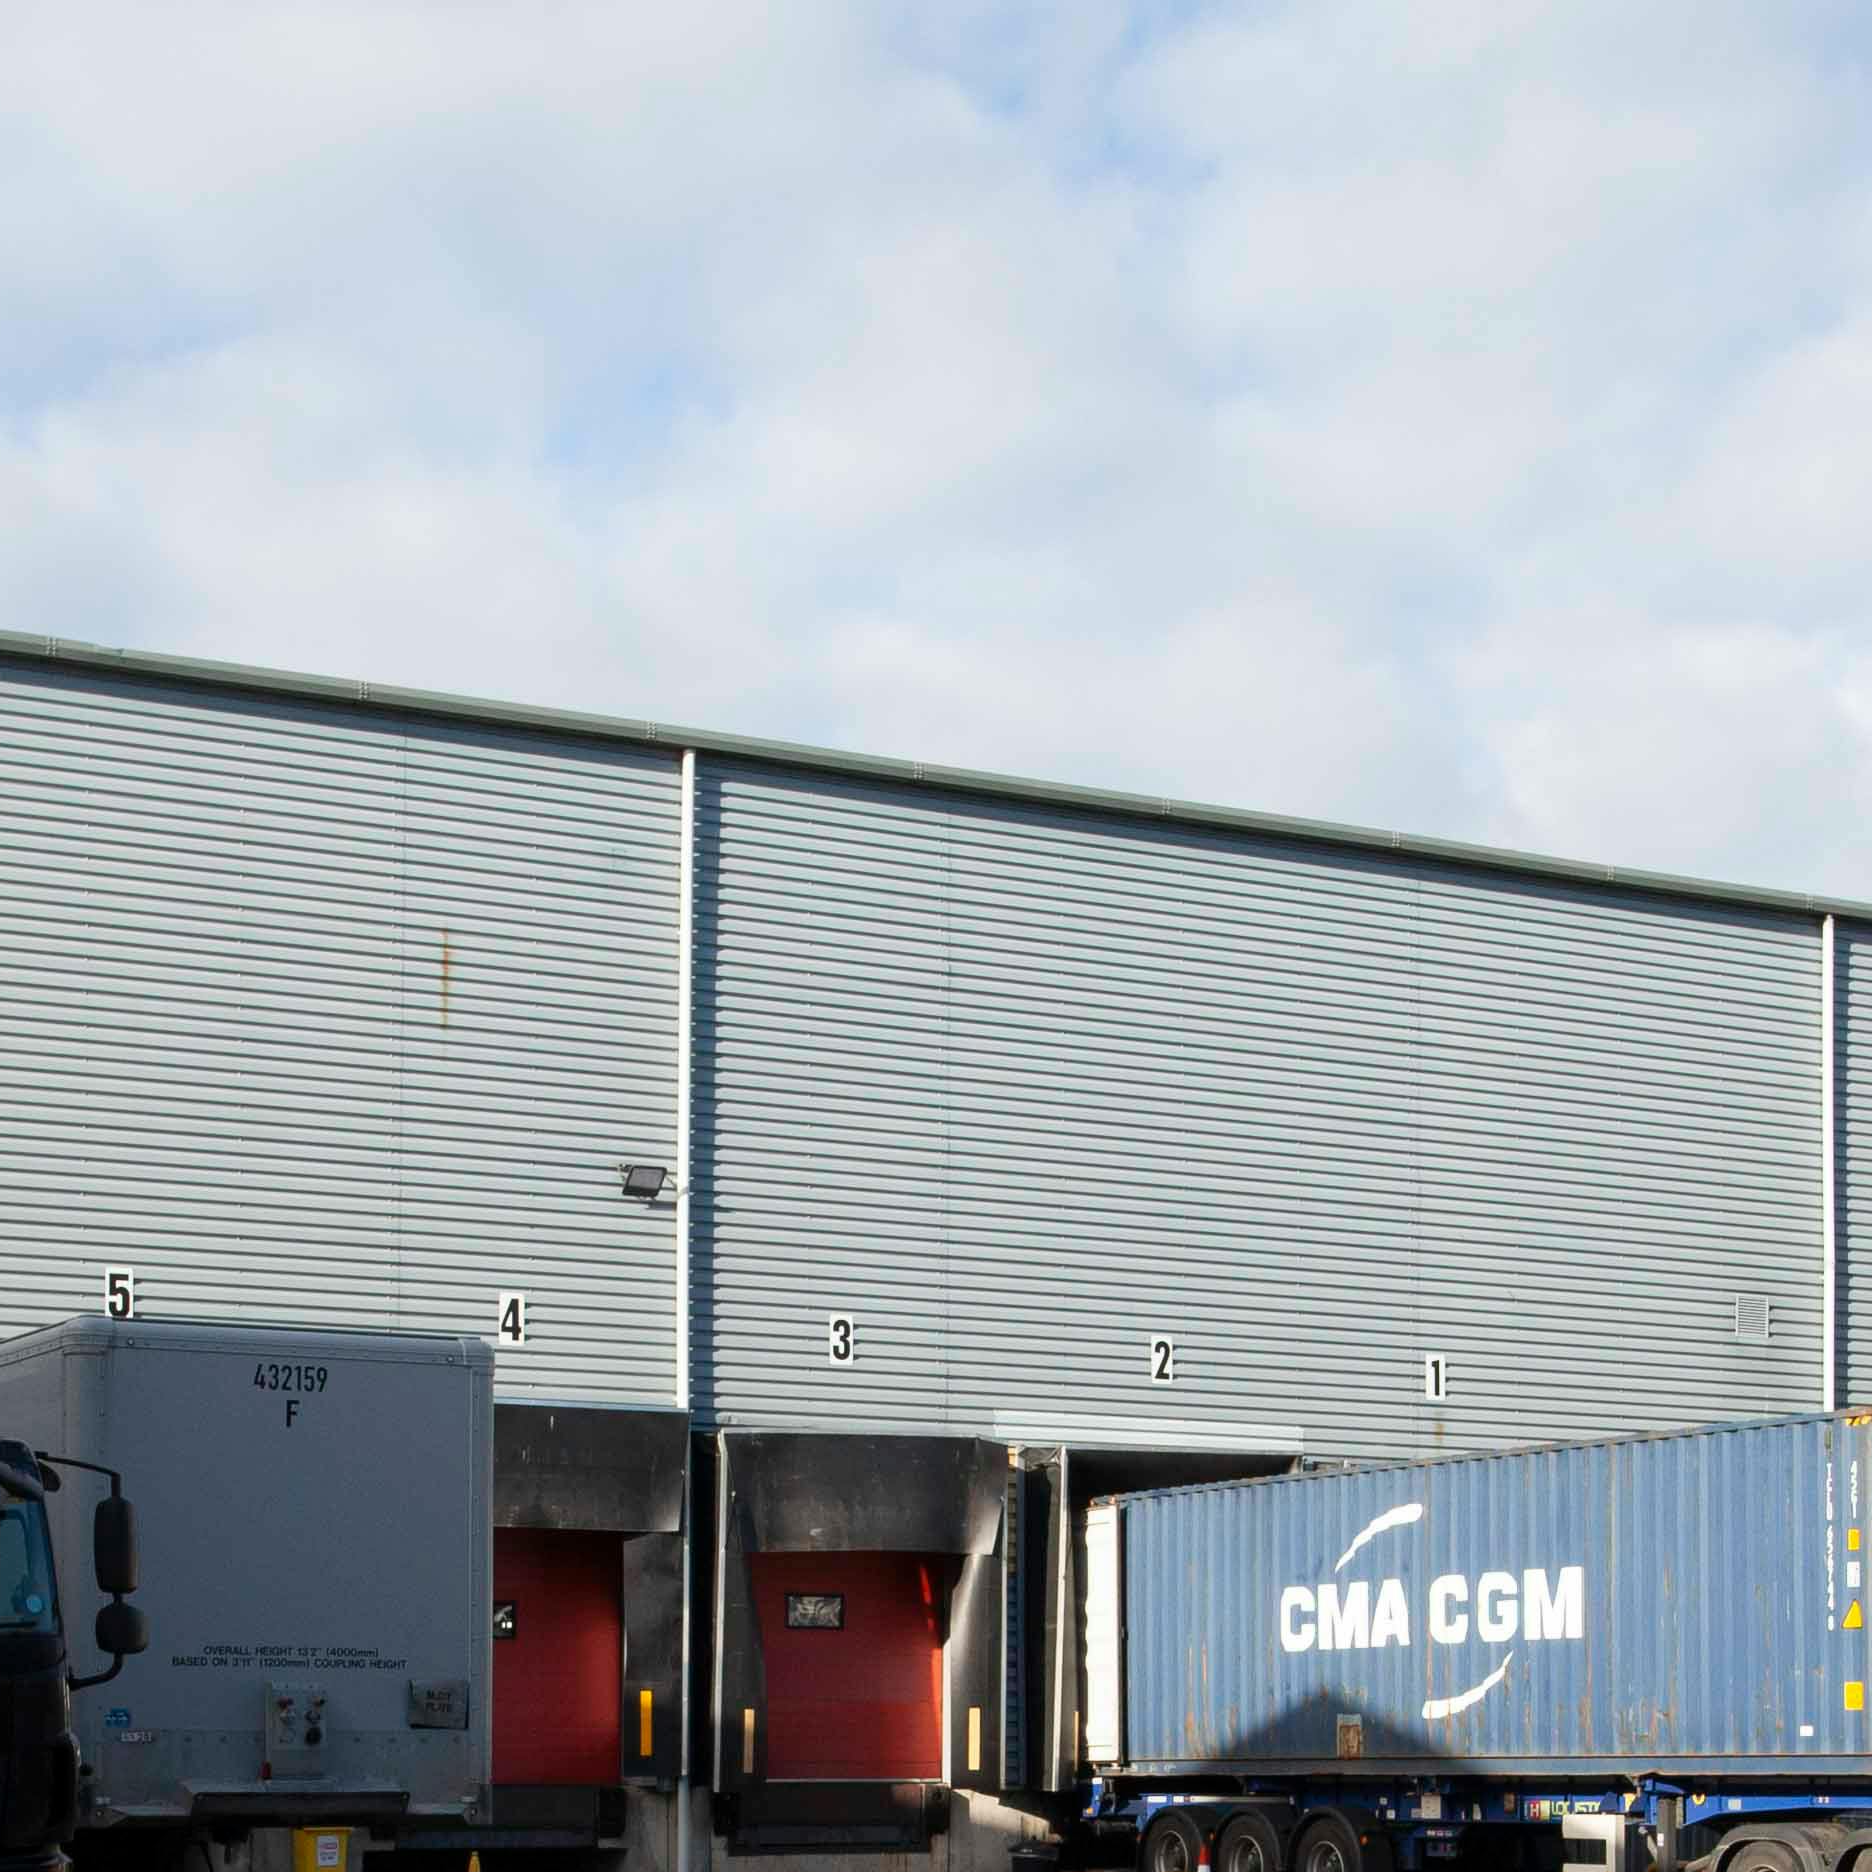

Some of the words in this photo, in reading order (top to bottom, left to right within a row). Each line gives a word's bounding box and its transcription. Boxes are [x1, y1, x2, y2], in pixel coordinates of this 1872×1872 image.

[108, 1273, 130, 1319] 5
[501, 1298, 522, 1341] 4
[833, 1319, 851, 1361] 3
[254, 1364, 328, 1393] 432159
[1154, 1341, 1170, 1380] 2
[1431, 1360, 1440, 1397] 1
[286, 1399, 301, 1427] F
[1280, 1578, 1410, 1652] CMA
[1428, 1565, 1584, 1645] CGM
[172, 1655, 208, 1666] BASED
[211, 1656, 229, 1667] ON
[314, 1657, 367, 1669] COUPLING
[369, 1658, 408, 1670] HEIGHT
[203, 1646, 250, 1656] OVERALL
[255, 1646, 292, 1657] HEIGHT
